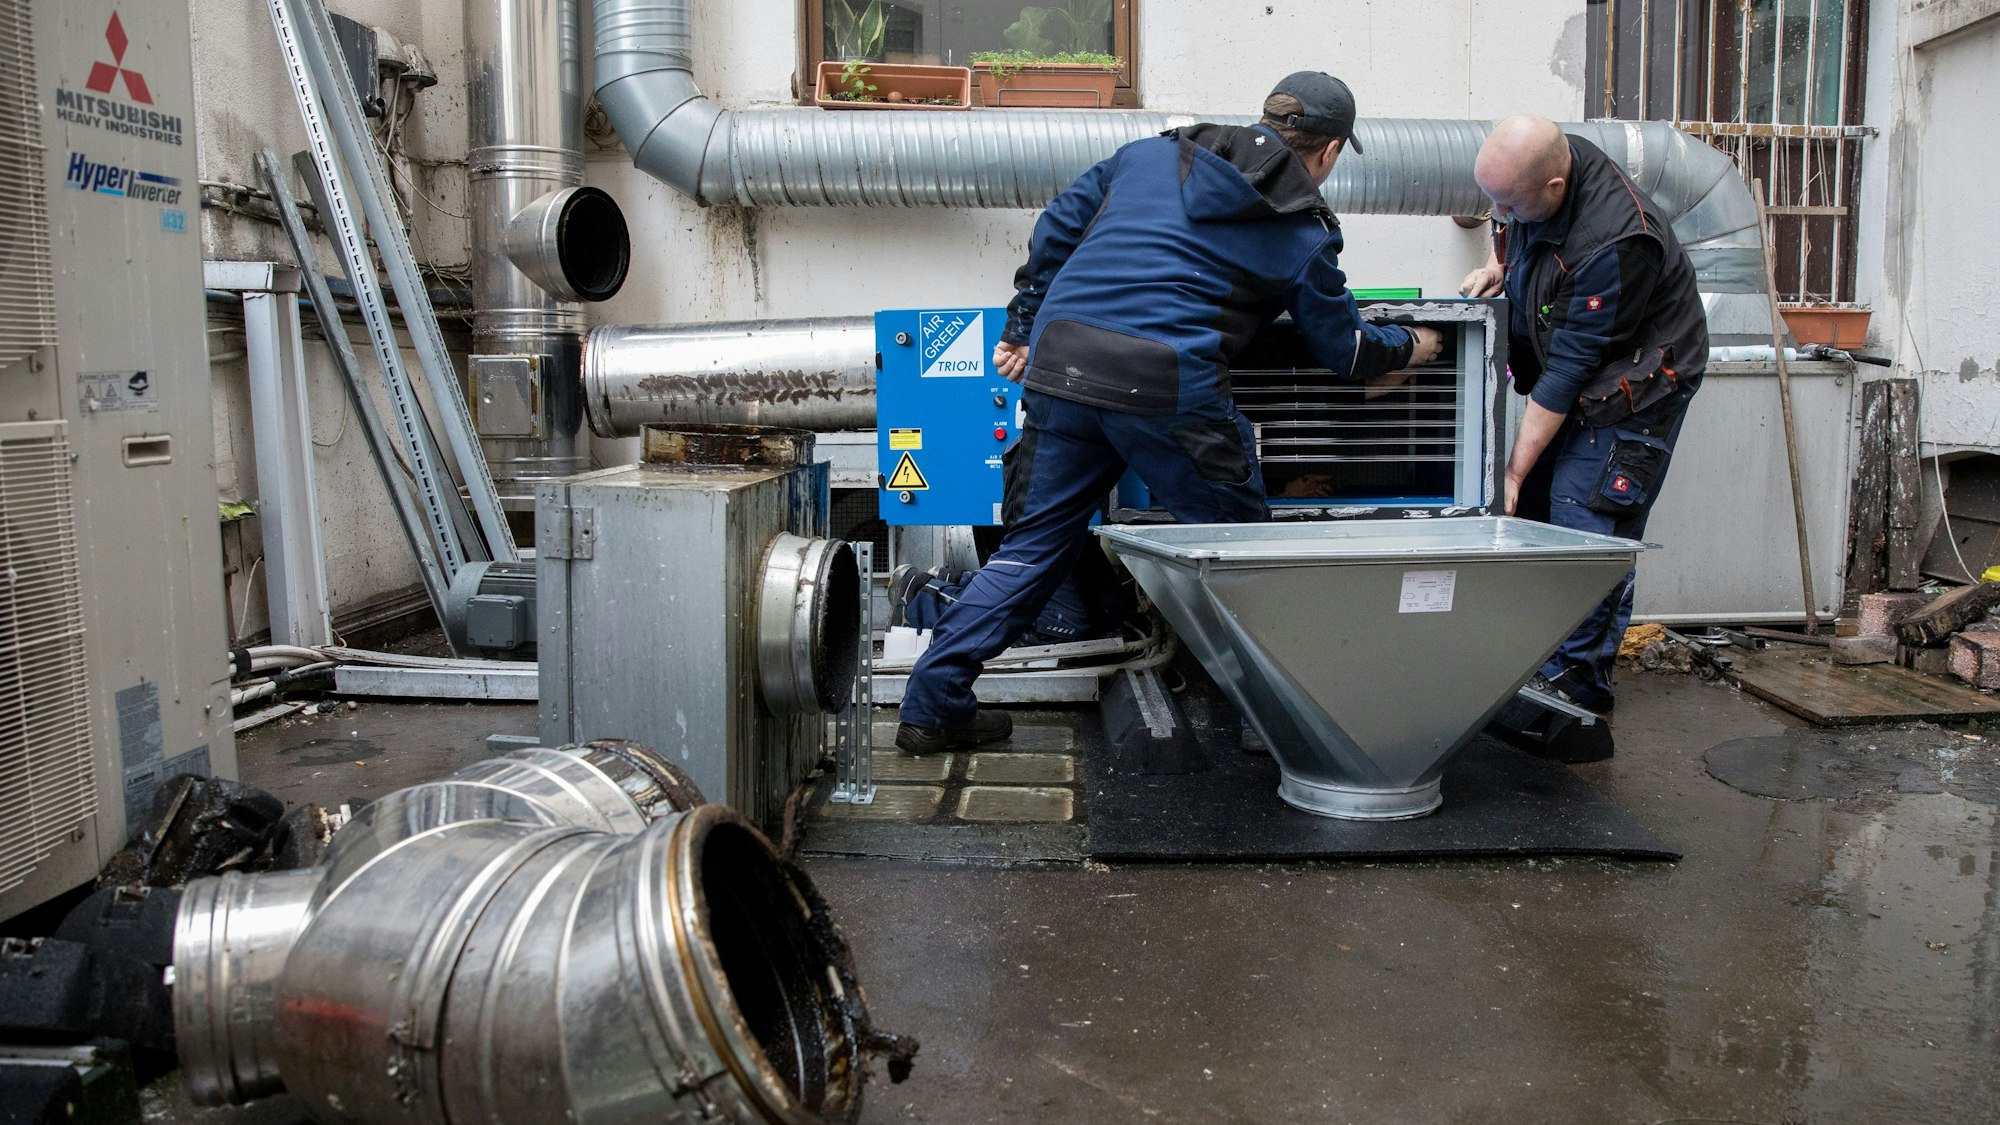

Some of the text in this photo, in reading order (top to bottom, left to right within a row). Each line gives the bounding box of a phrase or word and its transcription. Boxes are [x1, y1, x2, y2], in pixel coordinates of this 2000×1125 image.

[56, 88, 182, 133] MITSUBISHI
[56, 109, 182, 146] HEAVY INDUSTRIES
[67, 152, 182, 205] Hyper Inverter
[923, 314, 944, 339] AIR
[925, 316, 965, 359] GREEN
[938, 361, 978, 371] TRION
